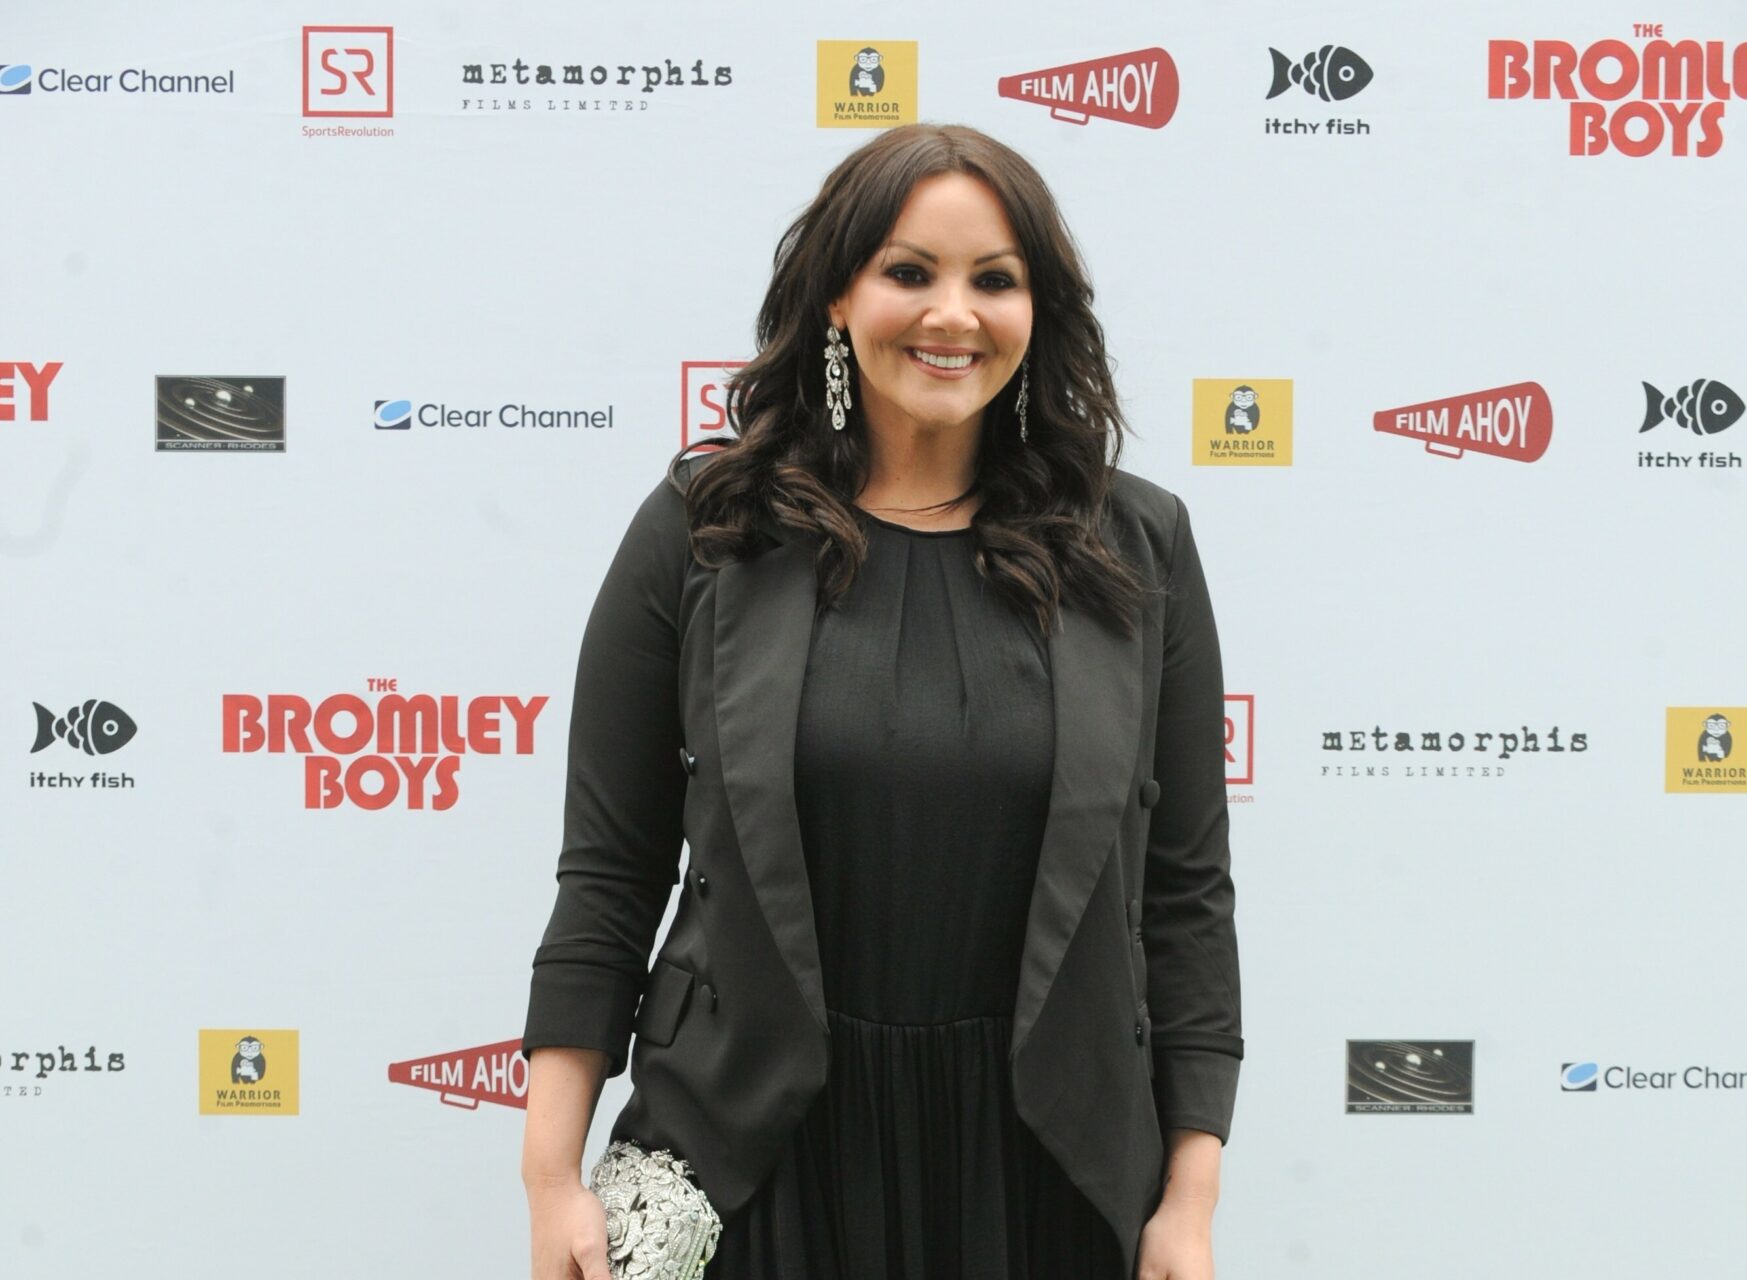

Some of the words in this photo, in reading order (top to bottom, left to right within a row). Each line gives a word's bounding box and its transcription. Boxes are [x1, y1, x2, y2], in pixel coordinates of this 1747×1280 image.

[1633, 24, 1663, 37] THE
[320, 48, 375, 96] SR
[38, 68, 112, 92] Clear
[119, 69, 233, 93] Channel
[1022, 77, 1074, 102] FILM
[1083, 61, 1158, 114] AHOY
[462, 99, 531, 110] FILMS
[548, 100, 647, 110] LIMITED
[834, 102, 900, 112] WARRIOR
[302, 126, 393, 138] SportsRevolution
[1266, 118, 1320, 134] itchy
[1326, 119, 1370, 134] fish
[1570, 102, 1725, 157] BOYS
[418, 404, 492, 427] Clear
[499, 404, 613, 428] Channel
[1396, 412, 1449, 436] FILM
[1458, 396, 1531, 448] AHOY
[165, 442, 221, 450] SCANNER
[227, 442, 277, 450] RHODES
[1210, 440, 1275, 450] WARRIOR
[1638, 452, 1692, 467] itchy
[1698, 452, 1742, 468] fish
[367, 679, 397, 692] THE
[222, 694, 549, 754] BROMLEY
[1322, 766, 1389, 776] FILMS
[1406, 767, 1504, 776] LIMITED
[1683, 768, 1747, 777] WARRIOR
[30, 772, 84, 787] itchy
[90, 772, 134, 788] fish
[305, 756, 460, 811] BOYS
[0, 1045, 125, 1079] rphis
[411, 1061, 464, 1088] FILM
[471, 1053, 528, 1096] AHO
[1604, 1066, 1677, 1089] Clear
[216, 1090, 281, 1100] WARRIOR
